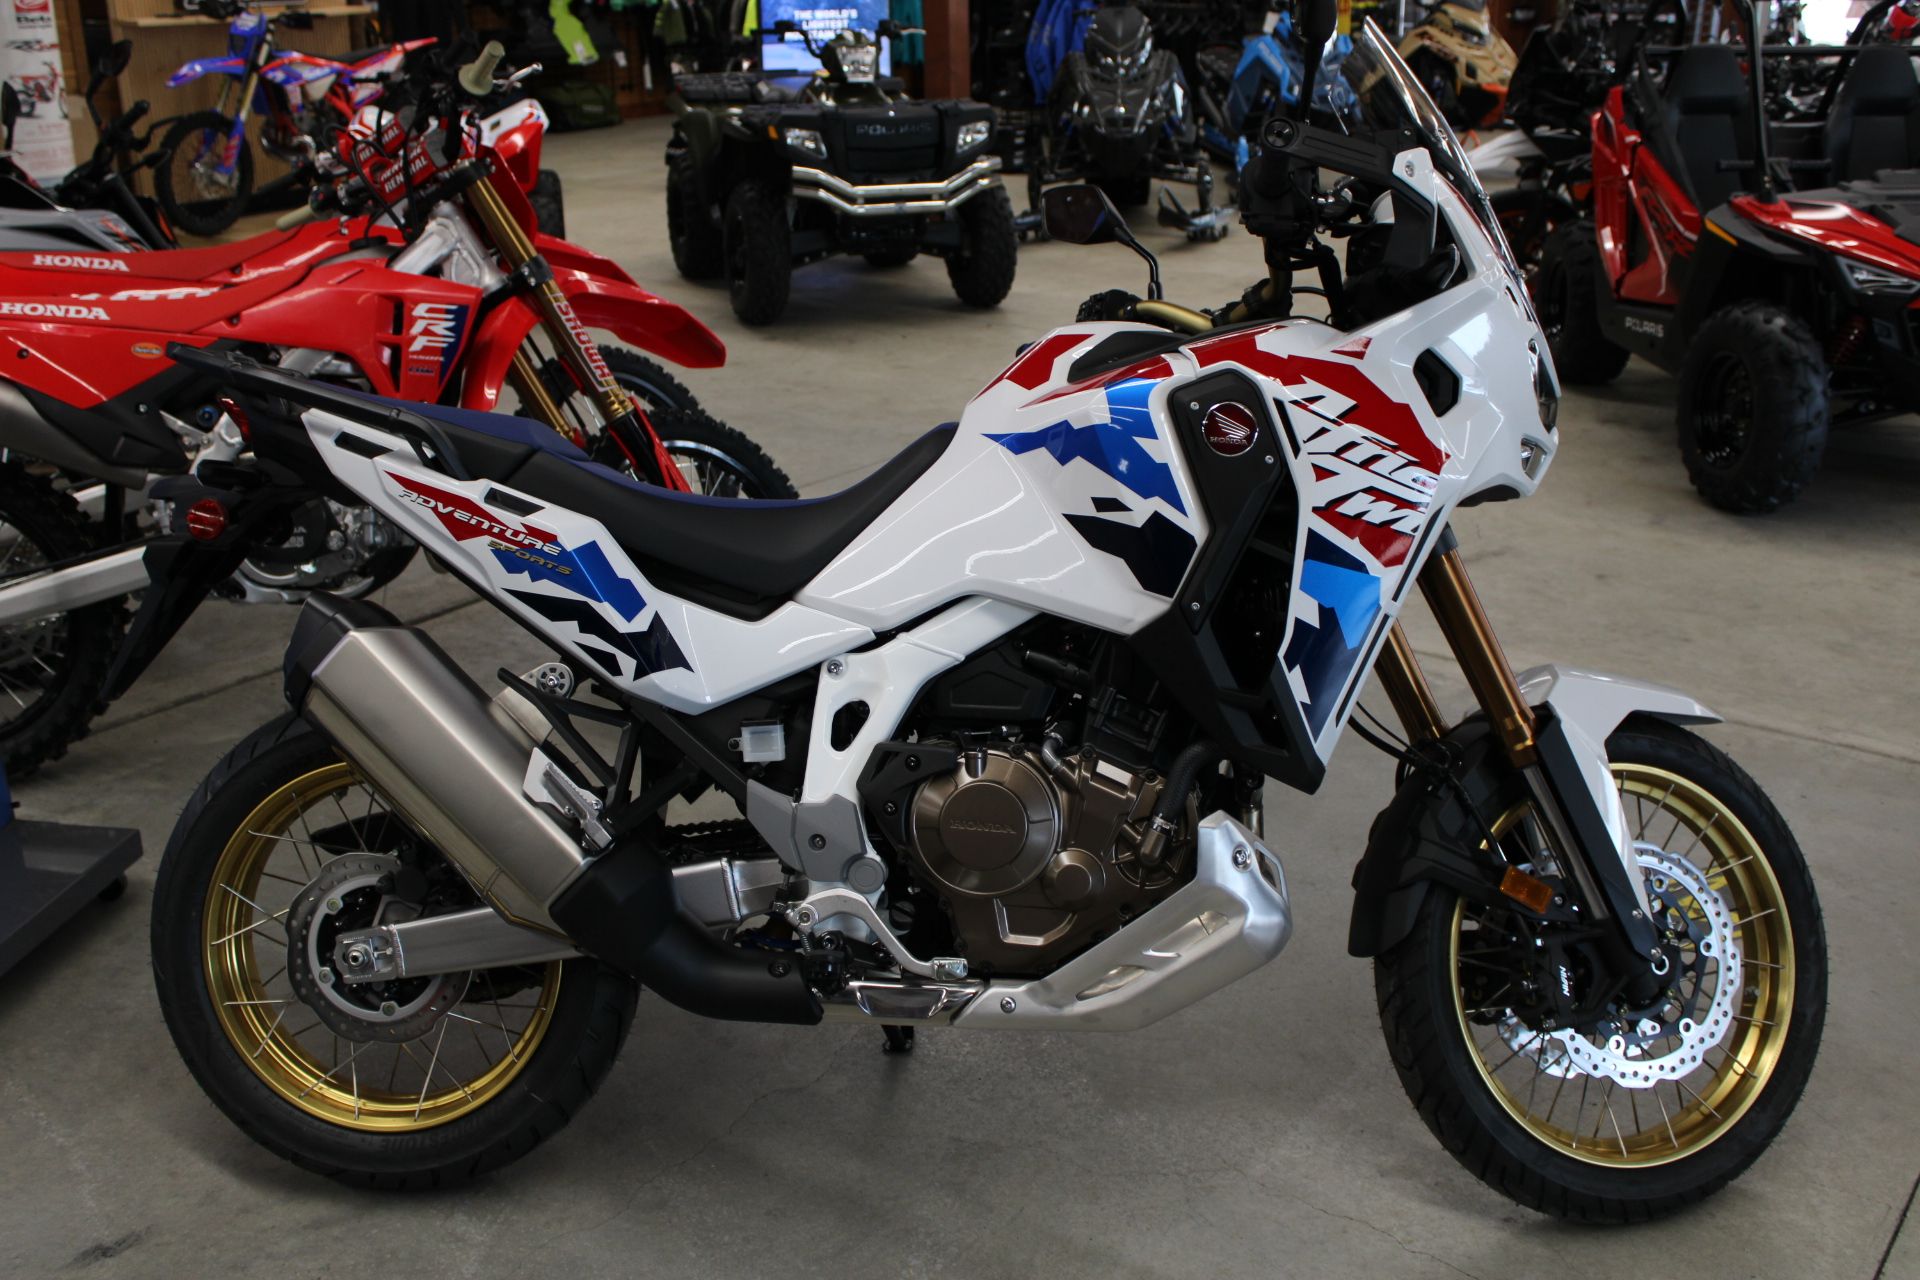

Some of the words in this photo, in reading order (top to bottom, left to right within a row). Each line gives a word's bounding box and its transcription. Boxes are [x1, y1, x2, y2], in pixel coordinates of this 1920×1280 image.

[794, 9, 813, 20] THE
[802, 19, 849, 30] LIGHTEST
[33, 254, 130, 272] HONDA
[0, 302, 110, 321] HONDA
[1624, 315, 1665, 338] POLARIS
[553, 301, 614, 382] SHOWA
[1209, 436, 1249, 446] HONDA
[398, 488, 562, 557] ADVENTURE
[487, 538, 573, 576] SPORTS
[949, 818, 1017, 835] HONDA
